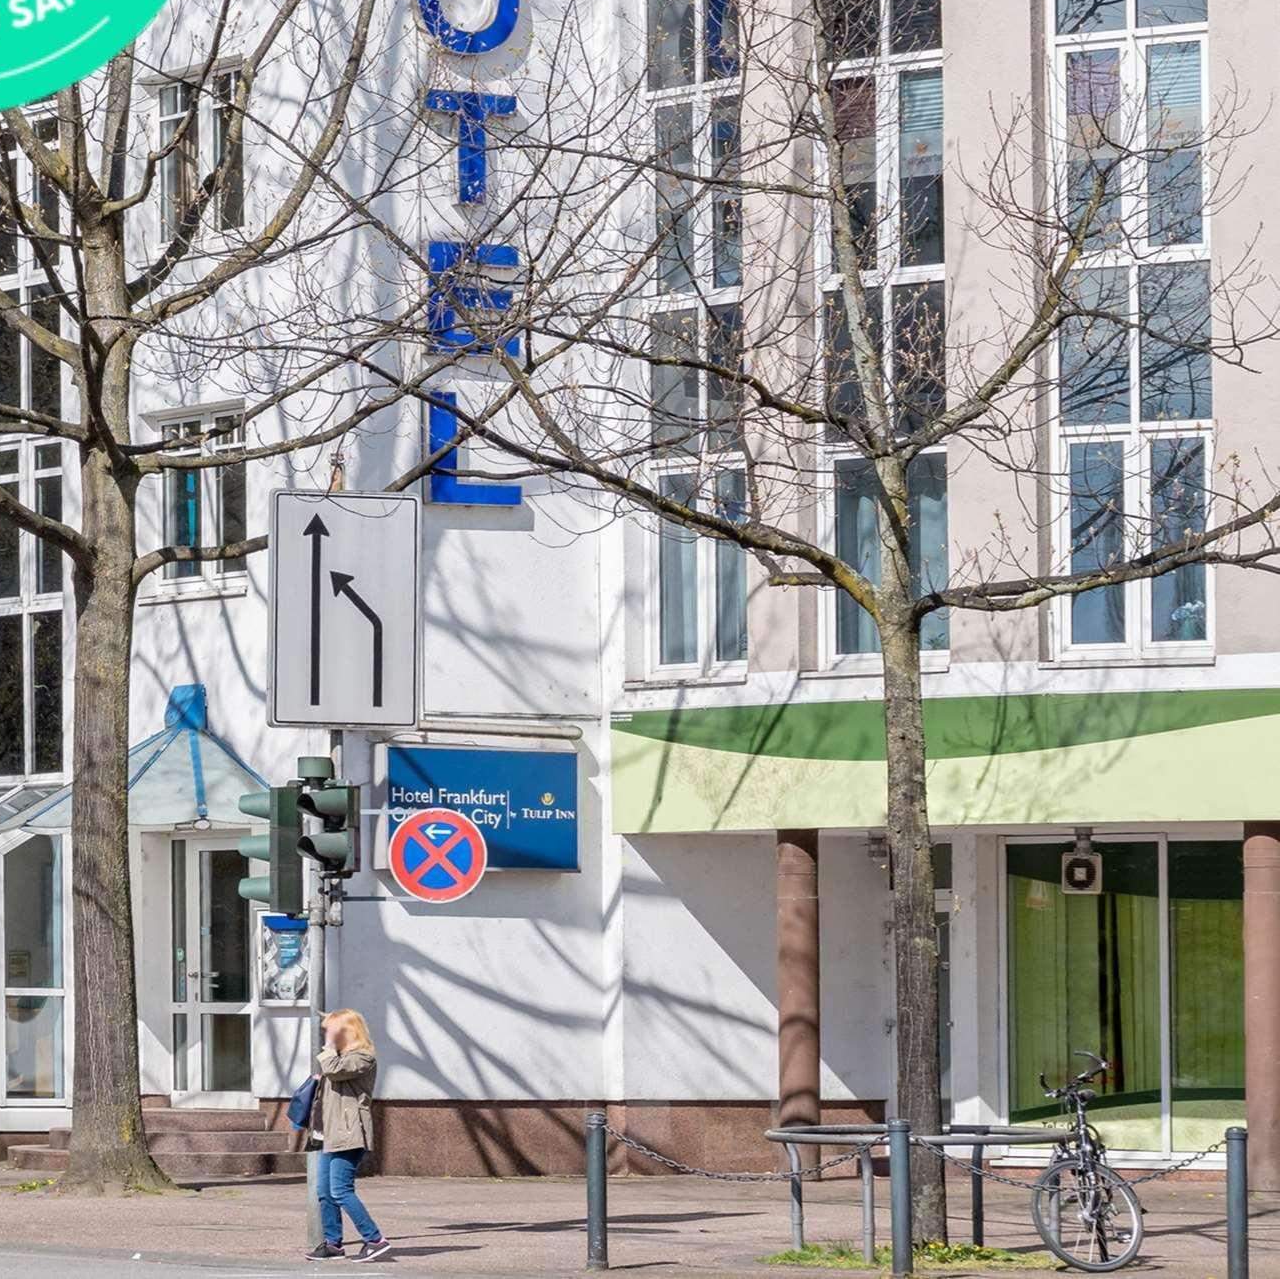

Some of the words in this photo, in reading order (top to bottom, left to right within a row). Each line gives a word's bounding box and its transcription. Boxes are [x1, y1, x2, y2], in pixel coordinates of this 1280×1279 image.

[392, 787, 433, 804] Hotel
[439, 787, 506, 806] Frankfurt
[471, 808, 502, 829] City
[521, 807, 553, 819] TULIP
[555, 808, 575, 819] INN
